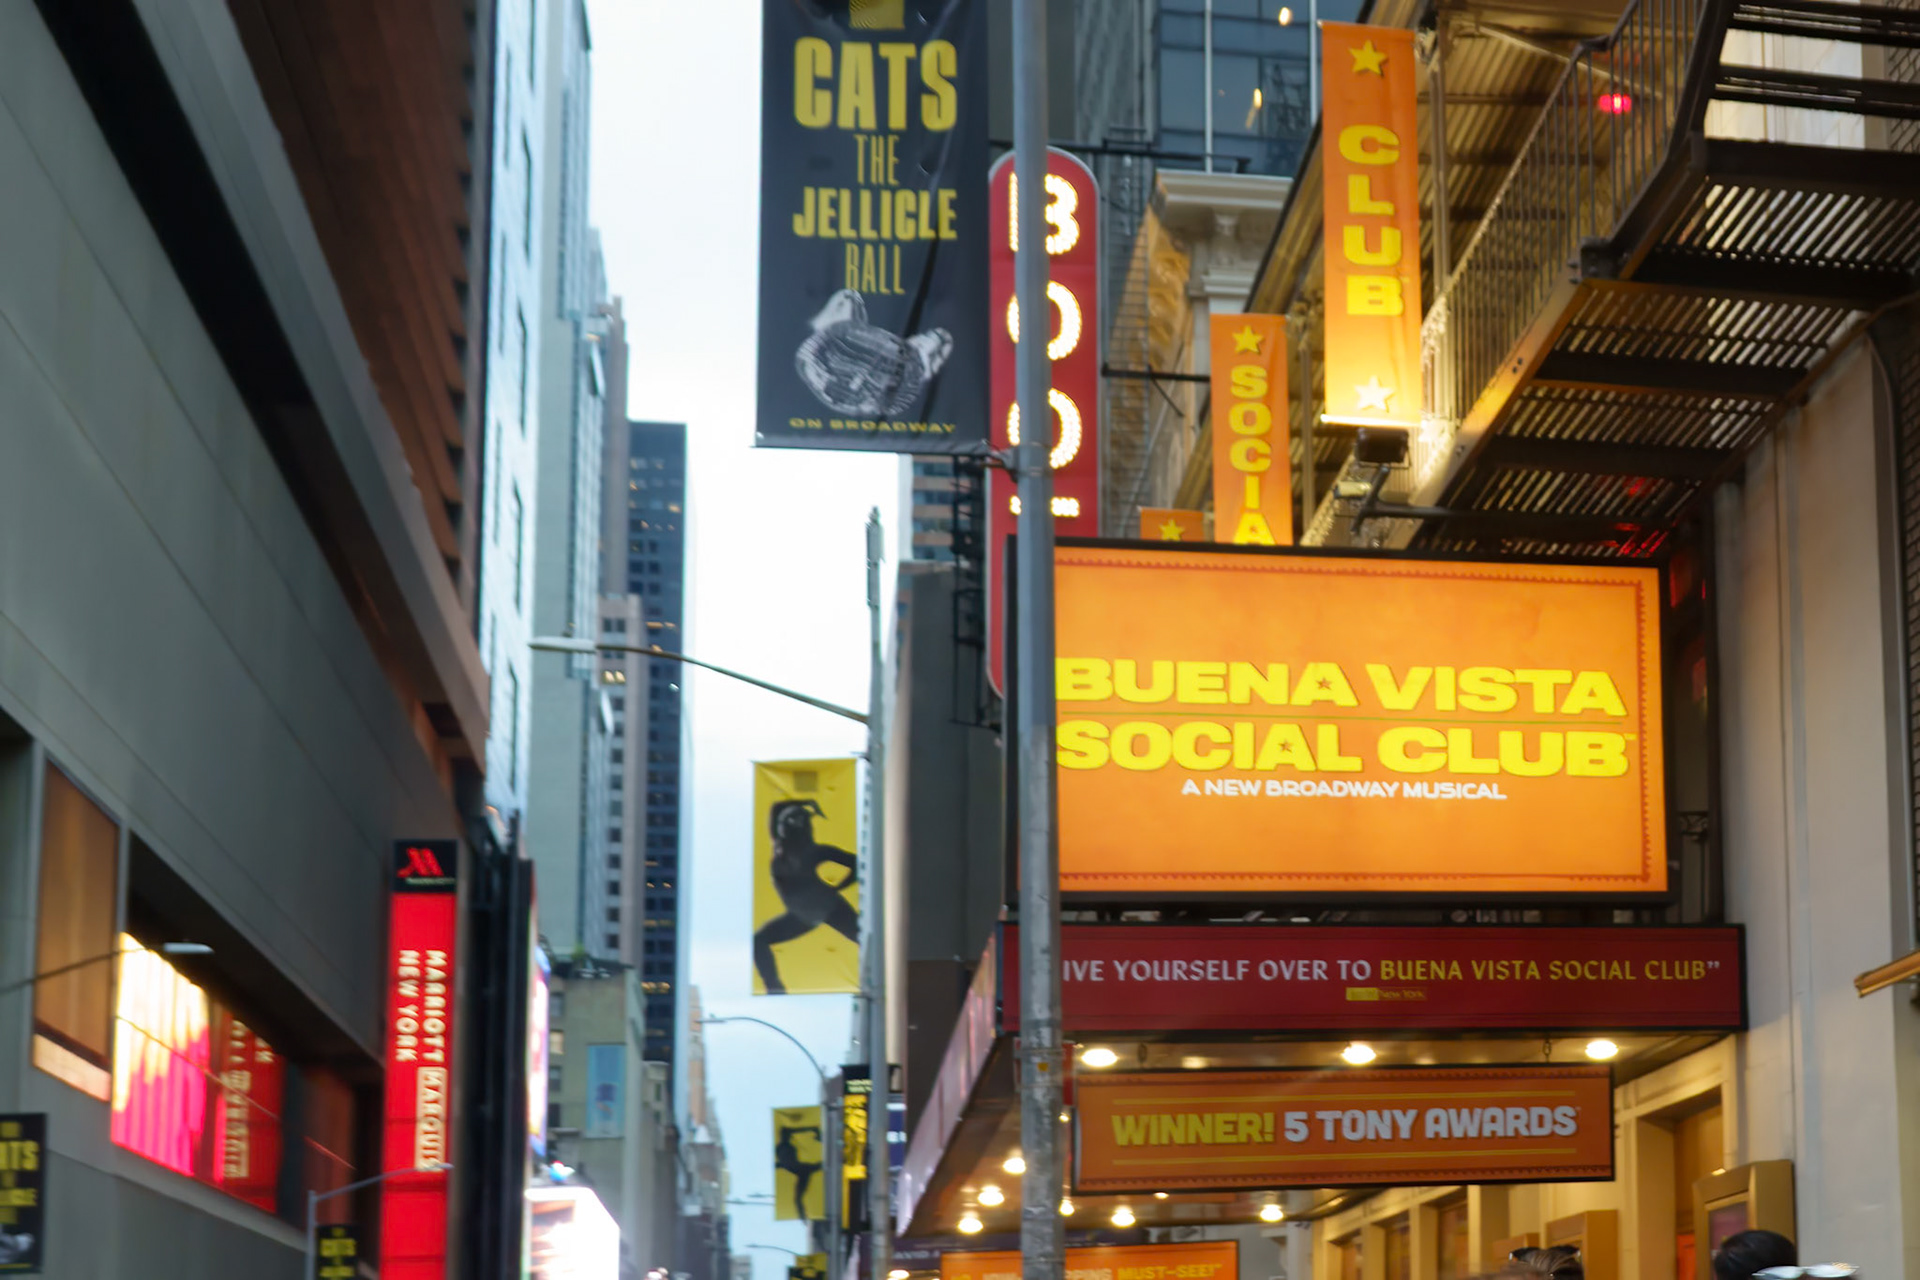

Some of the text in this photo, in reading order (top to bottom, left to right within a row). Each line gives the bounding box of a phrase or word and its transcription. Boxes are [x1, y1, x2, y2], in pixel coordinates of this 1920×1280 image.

[794, 37, 958, 132] CATS
[854, 134, 900, 187] THE
[793, 187, 958, 240] JELLICLE
[1338, 124, 1404, 316] CLUB
[845, 243, 905, 295] BALL
[1006, 173, 1083, 518] BOO
[789, 418, 957, 434] ON BROADWAY
[1228, 364, 1276, 546] SOCIA
[1055, 657, 1628, 716] BUENA VISTA
[1056, 719, 1363, 772] SOCIAL
[1181, 778, 1508, 800] A NEW BROADWAY MUSICAL
[1062, 959, 1105, 981] IVE
[1113, 960, 1250, 981] YOURSELF
[1258, 960, 1328, 981] OVER
[1337, 959, 1372, 981] TO
[1379, 959, 1463, 980] BUENA
[1471, 959, 1541, 980] VISTA
[1549, 959, 1637, 981] SOCIAL
[396, 950, 420, 1062] NEW YORK
[423, 950, 448, 1062] MARRIOTT
[1111, 1105, 1577, 1146] WINNER! 5 TONY AWARDS
